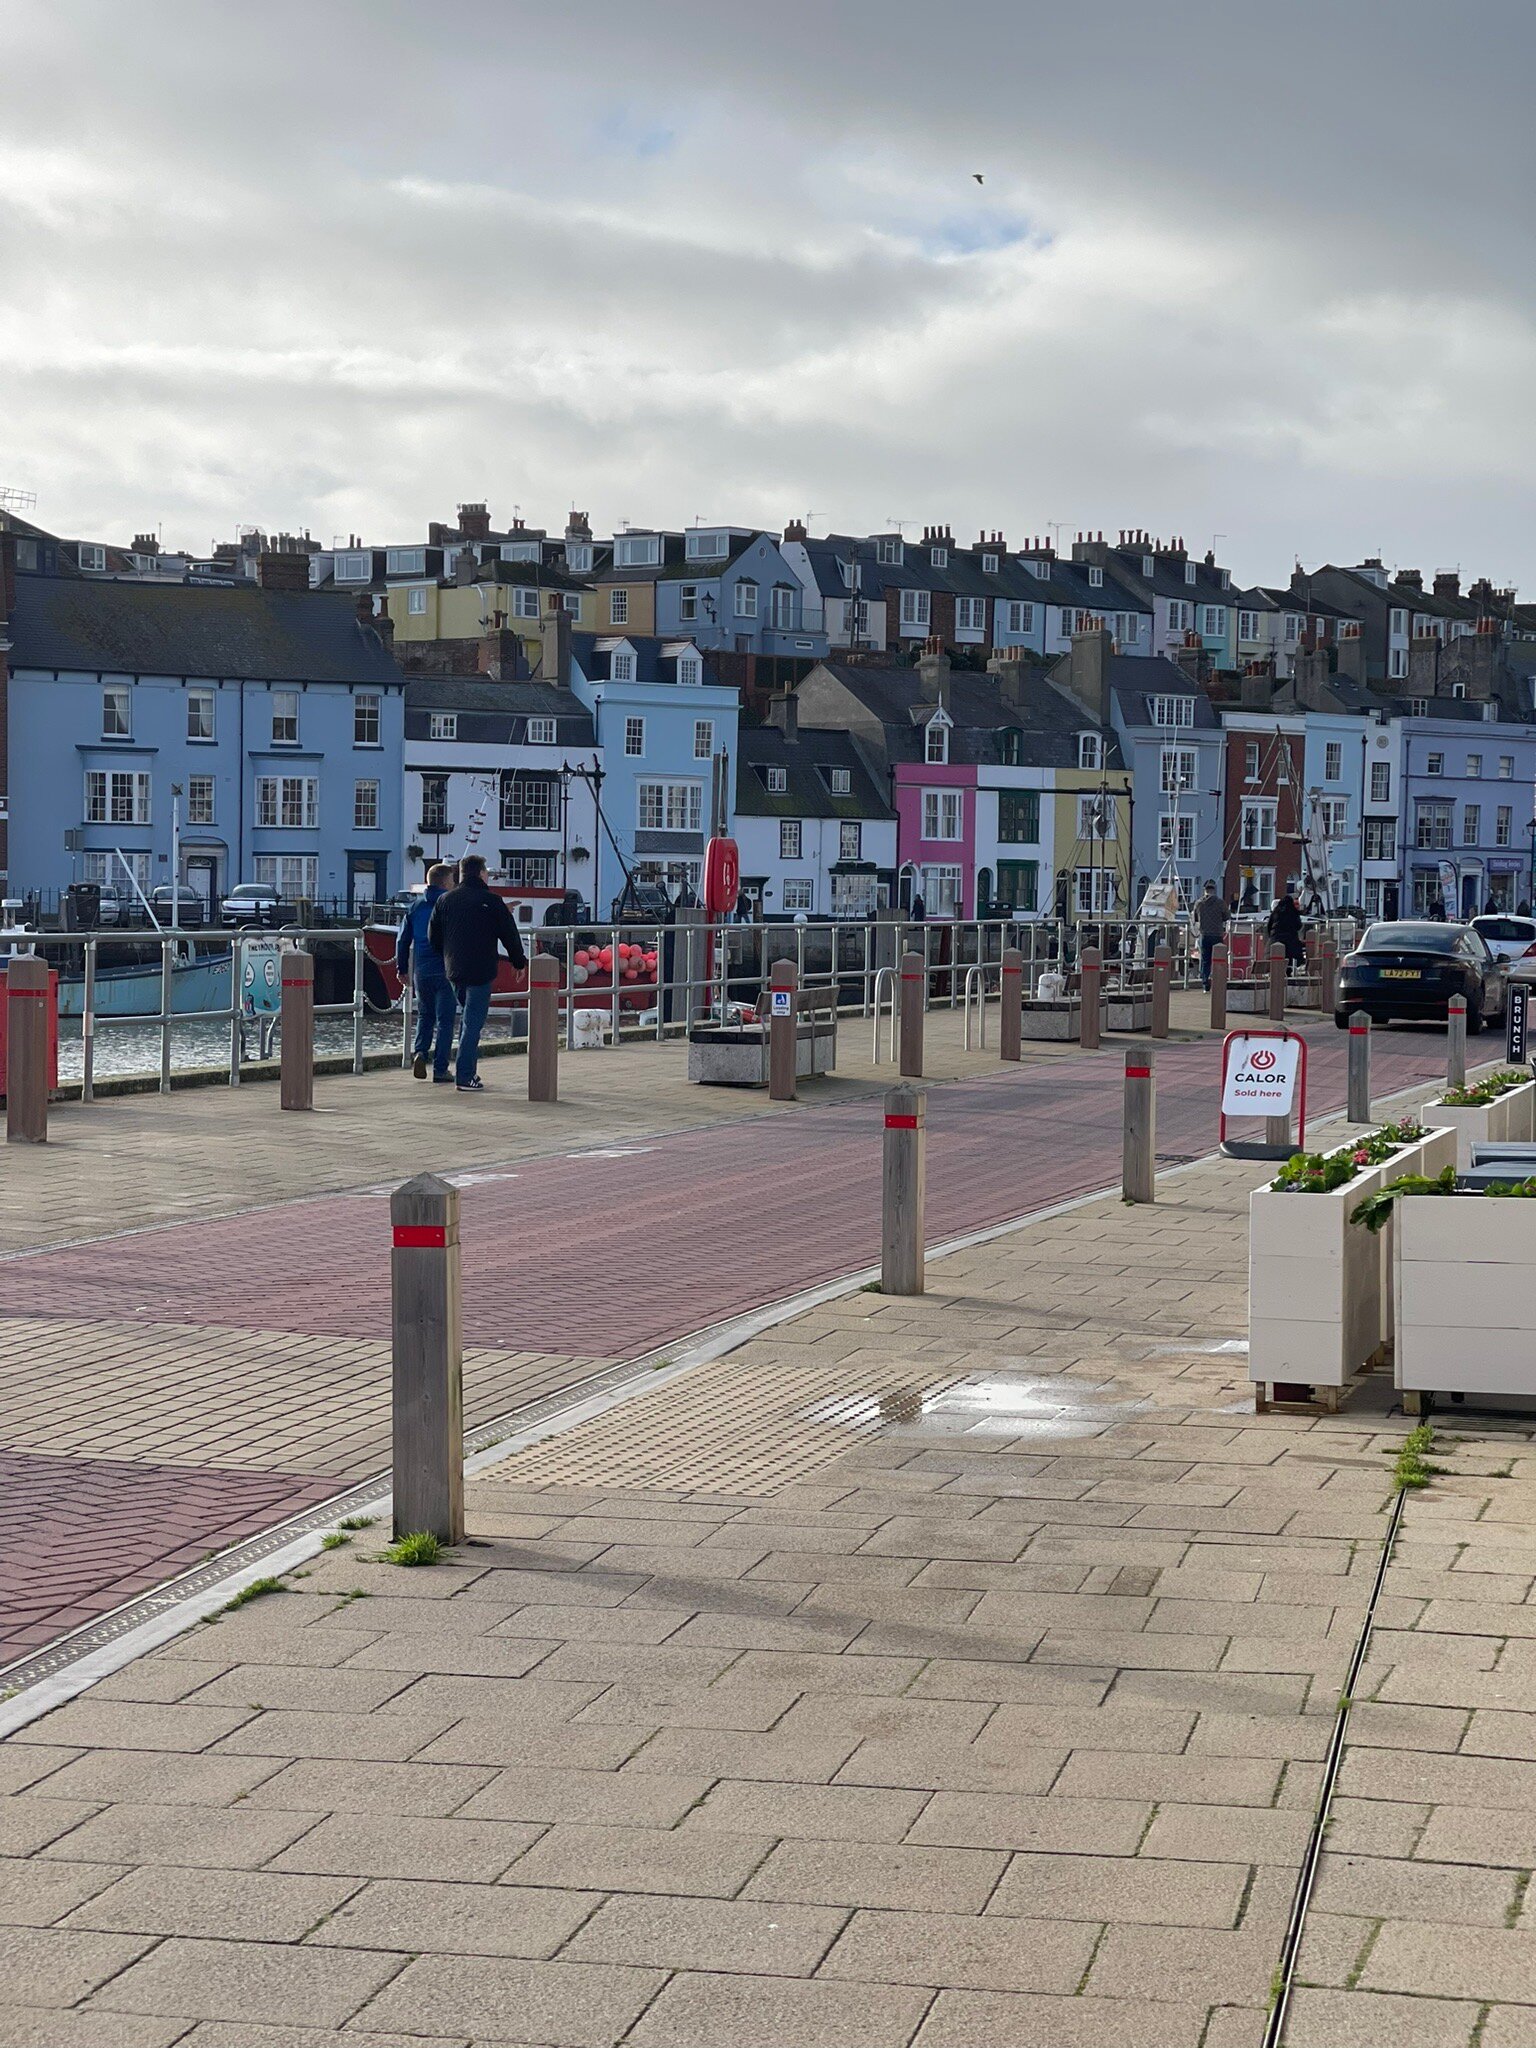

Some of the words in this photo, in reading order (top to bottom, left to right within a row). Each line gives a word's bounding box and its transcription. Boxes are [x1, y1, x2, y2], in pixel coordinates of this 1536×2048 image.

[1512, 996, 1522, 1053] BRUNCH
[1235, 1073, 1286, 1084] CALOR
[1234, 1089, 1257, 1097] Sold
[1259, 1089, 1282, 1098] here
